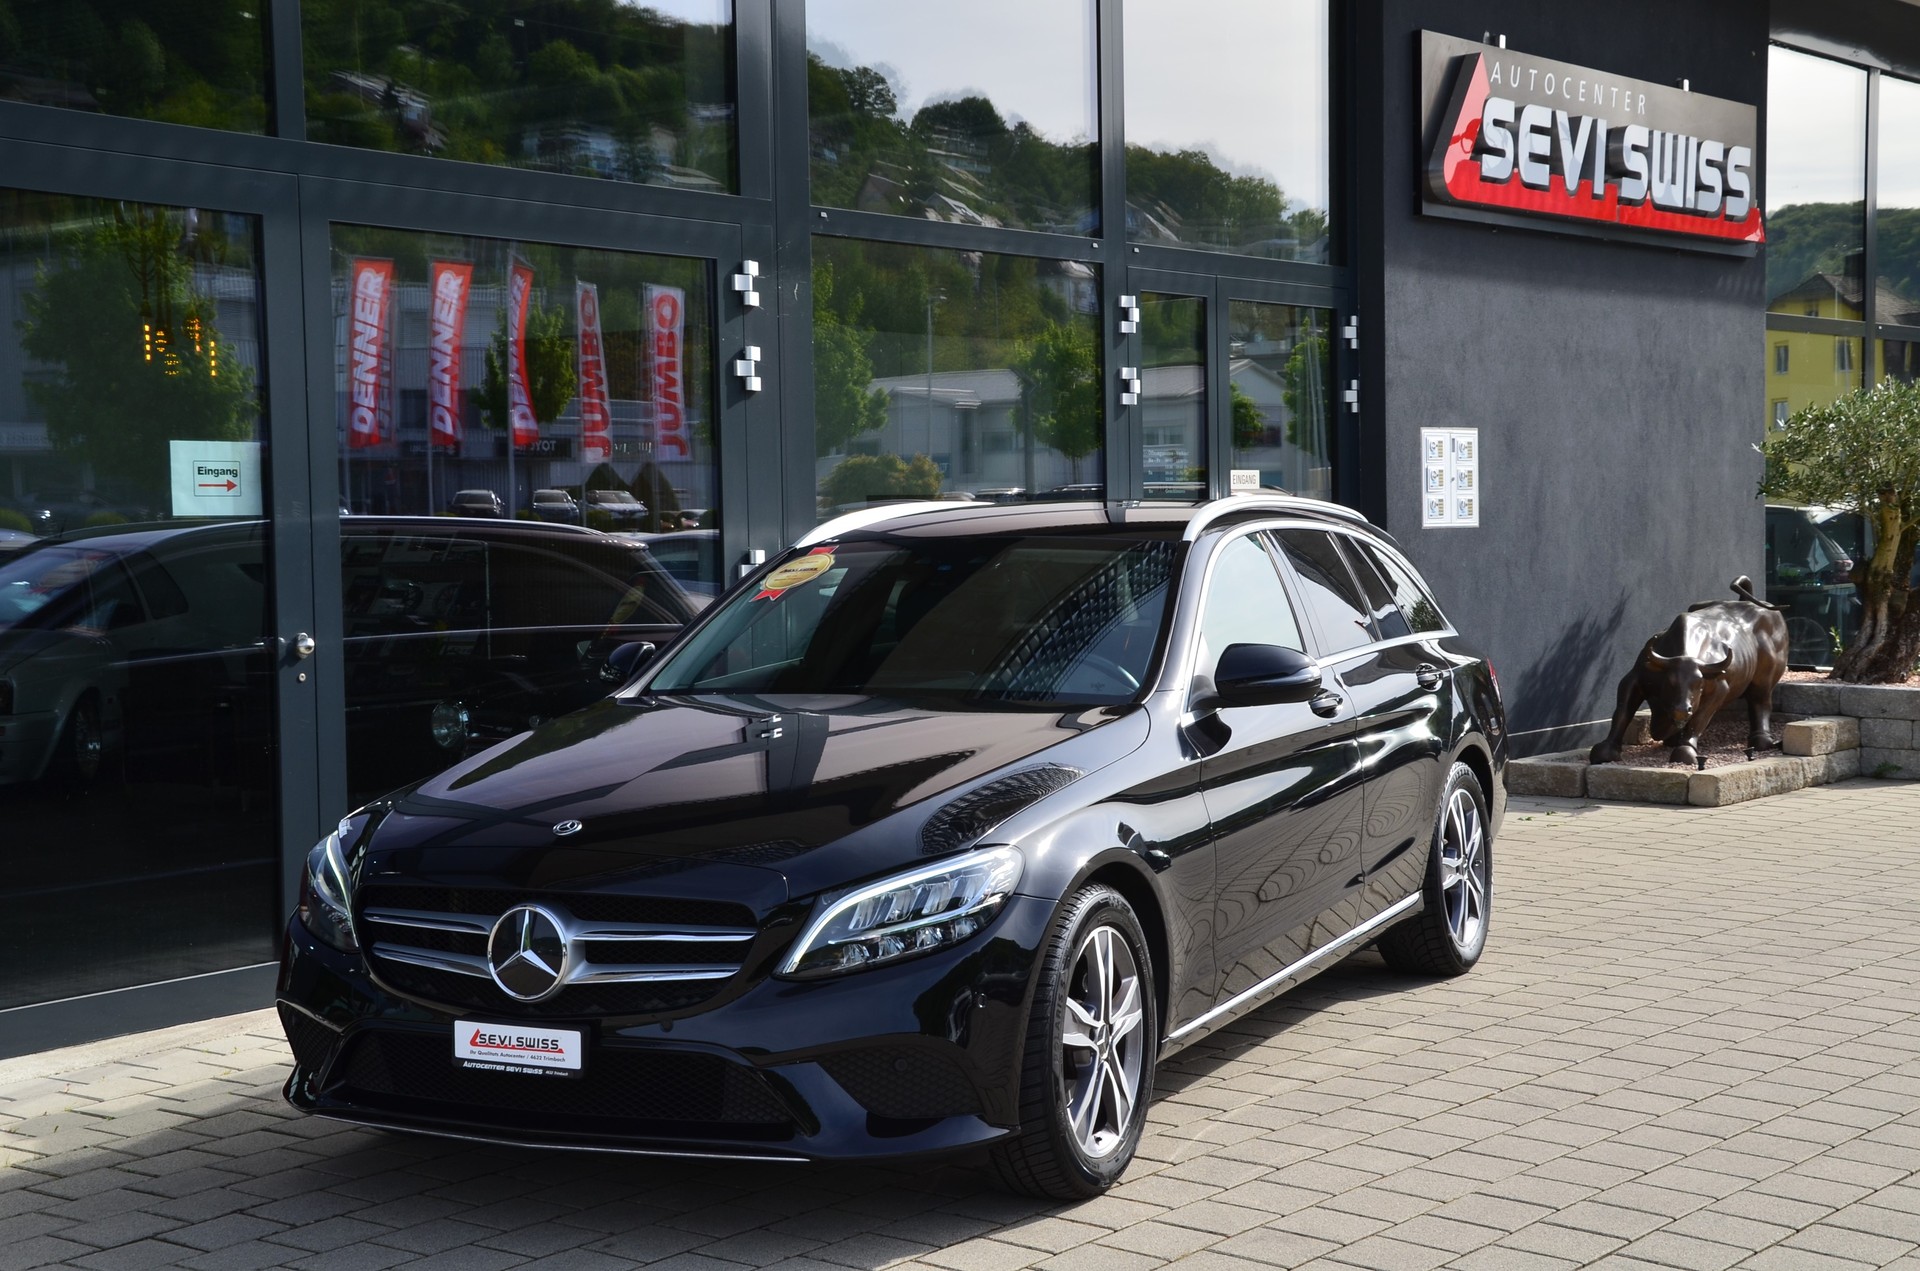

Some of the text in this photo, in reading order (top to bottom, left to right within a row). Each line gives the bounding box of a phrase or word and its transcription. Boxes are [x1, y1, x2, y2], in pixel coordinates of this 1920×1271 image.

[1489, 61, 1647, 116] AUTOCENTER
[1480, 97, 1752, 218] SEVI SWISS
[351, 267, 386, 434] DENNER
[430, 269, 464, 435] DENNER
[580, 287, 612, 458] JUMBO
[655, 292, 688, 457] JUMBO
[197, 466, 238, 478] Eingang
[1232, 474, 1257, 485] EINGANG
[478, 1033, 559, 1050] SEVI SWISS
[505, 1065, 522, 1073] SEVI
